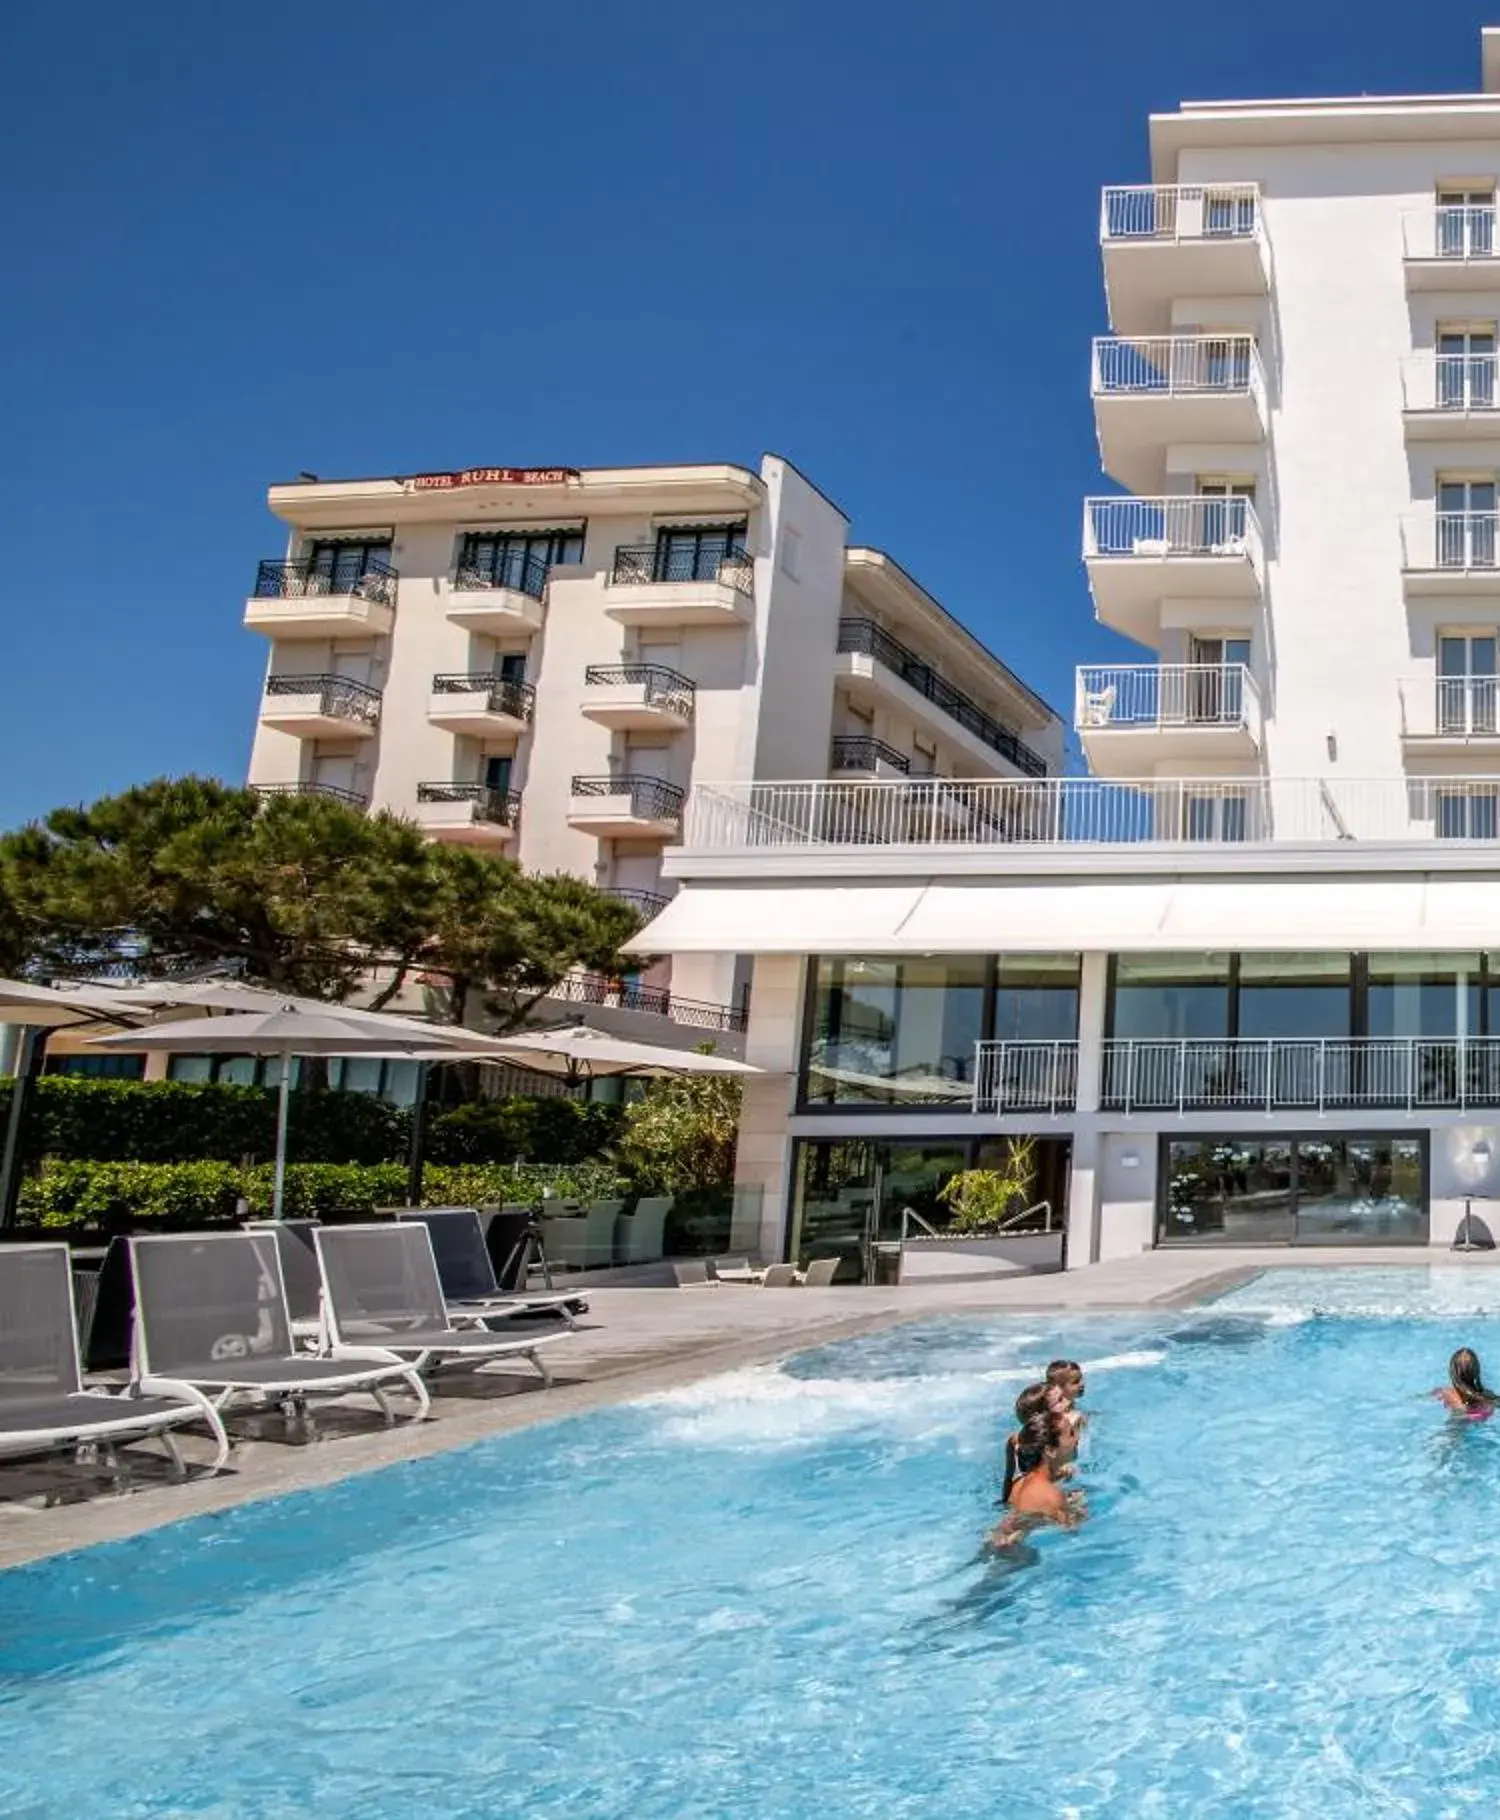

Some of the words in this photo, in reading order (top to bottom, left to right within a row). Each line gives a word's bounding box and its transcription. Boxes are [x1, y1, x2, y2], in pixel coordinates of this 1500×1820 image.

[416, 475, 453, 487] HOTEL
[461, 469, 513, 483] RUHL
[523, 470, 563, 483] BEACH
